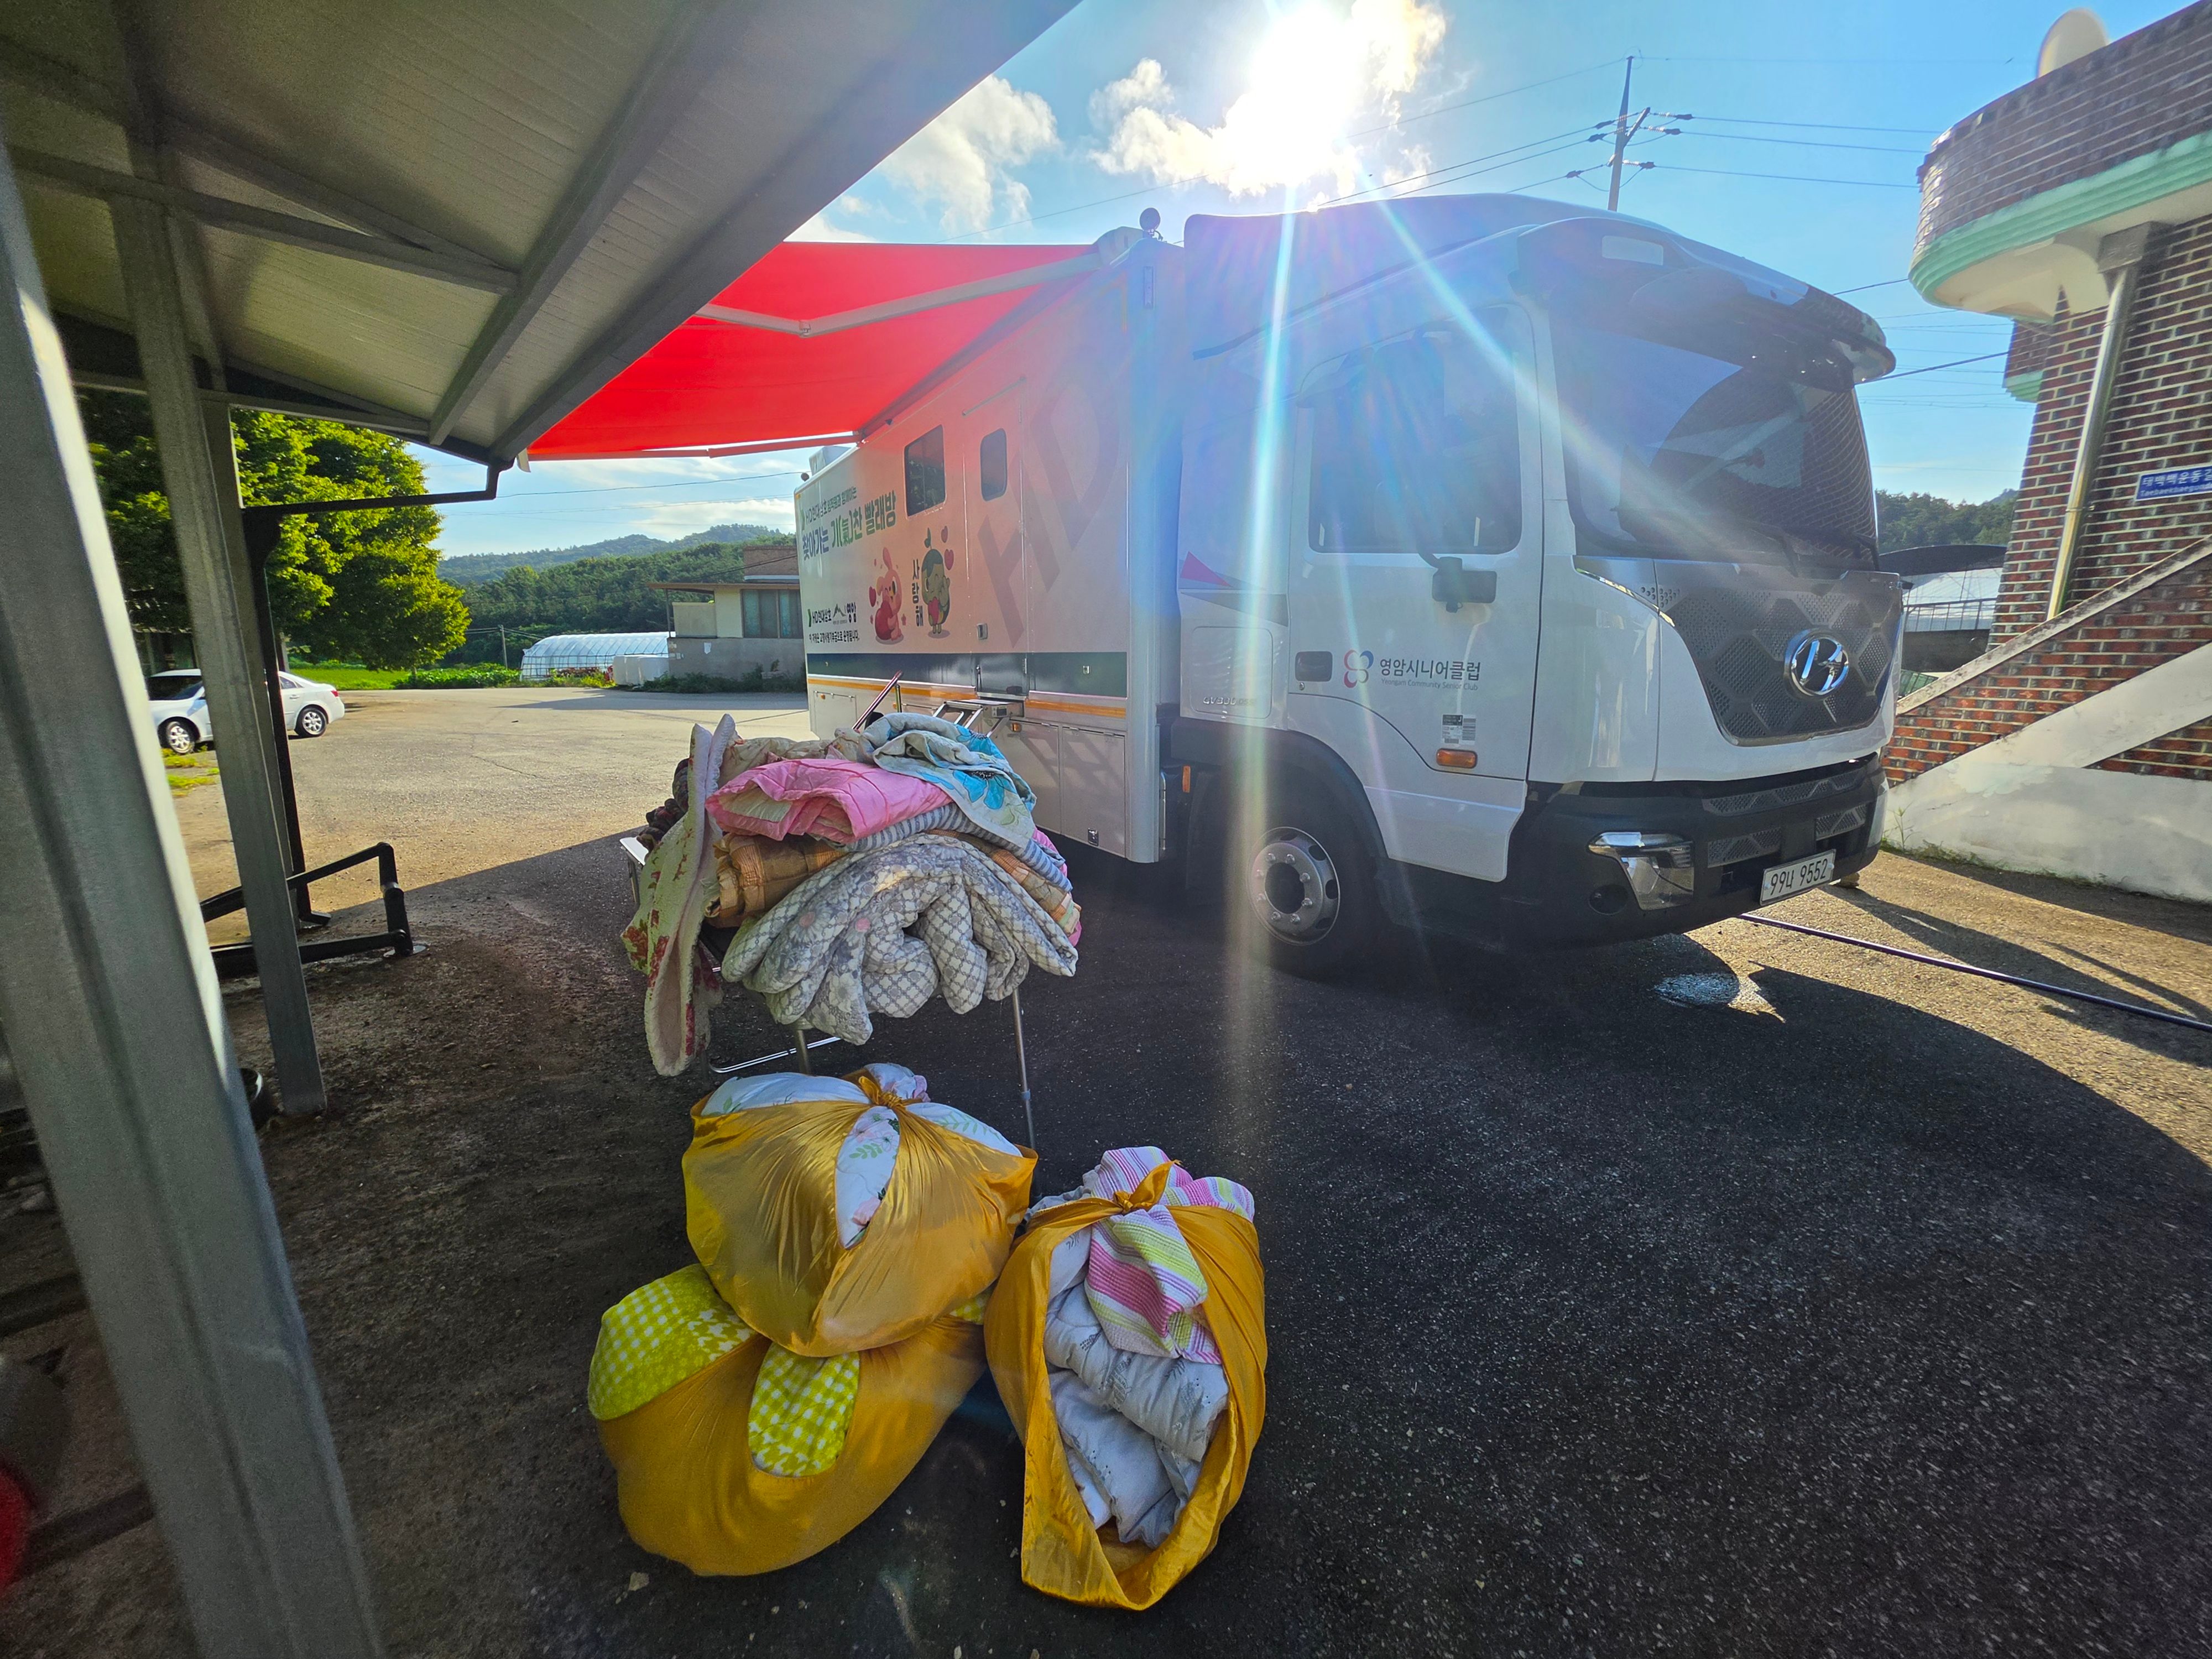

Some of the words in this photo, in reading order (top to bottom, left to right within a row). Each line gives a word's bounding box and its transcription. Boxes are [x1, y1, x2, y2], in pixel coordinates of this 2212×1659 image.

[802, 526, 830, 561] 찾아가는
[864, 490, 897, 536] 빨래방
[912, 559, 924, 627] 사랑해
[1380, 658, 1481, 681] 영암시니어클럽
[1381, 678, 1406, 687] Yeongam
[1407, 680, 1441, 689] Community
[1463, 683, 1478, 691] Club
[1770, 870, 1794, 895] 99나
[1799, 858, 1828, 886] 9552
